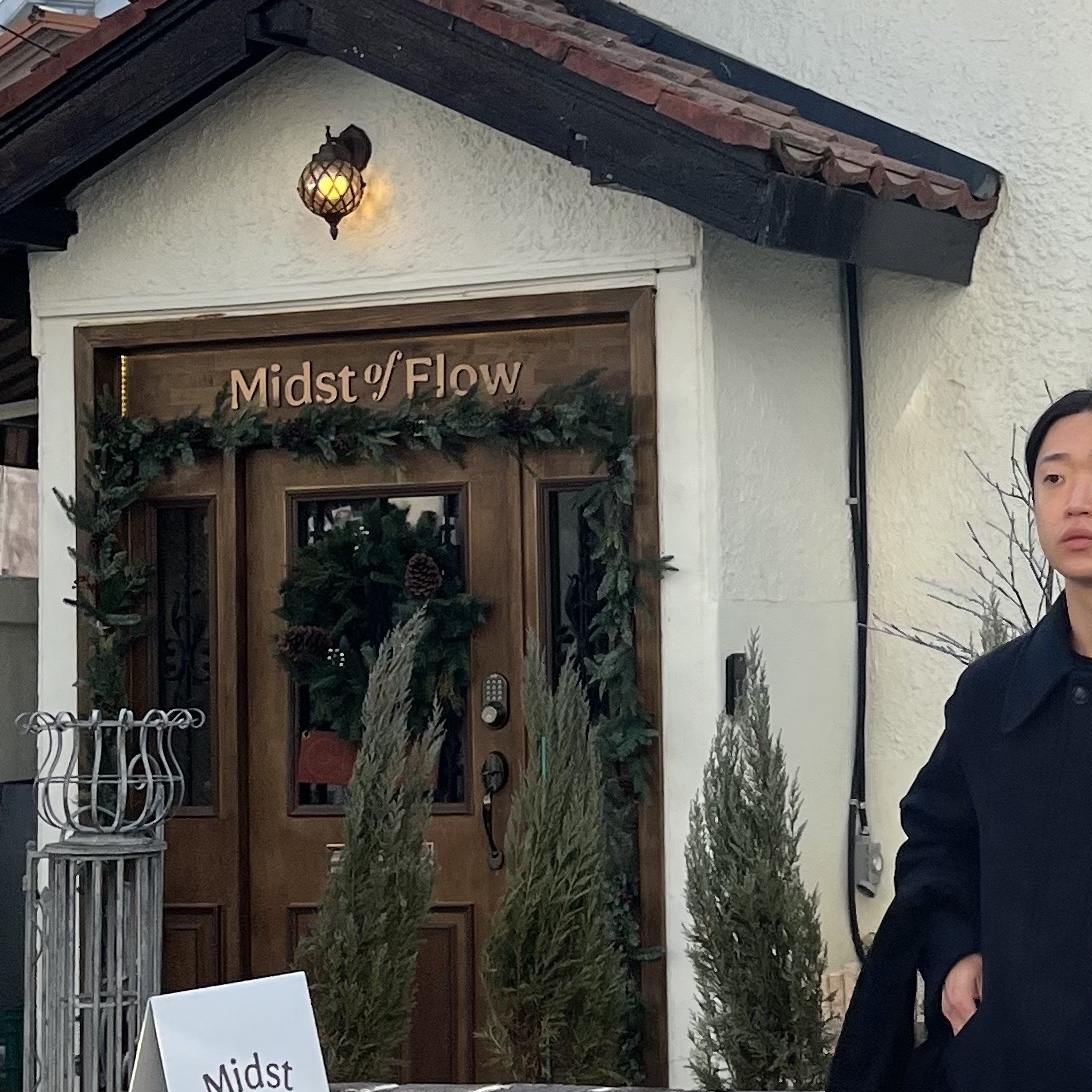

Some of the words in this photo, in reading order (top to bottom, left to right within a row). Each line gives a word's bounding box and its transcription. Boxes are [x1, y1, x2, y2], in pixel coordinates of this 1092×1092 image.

[230, 360, 358, 410] Midst
[364, 349, 403, 402] of
[406, 353, 522, 400] Flow
